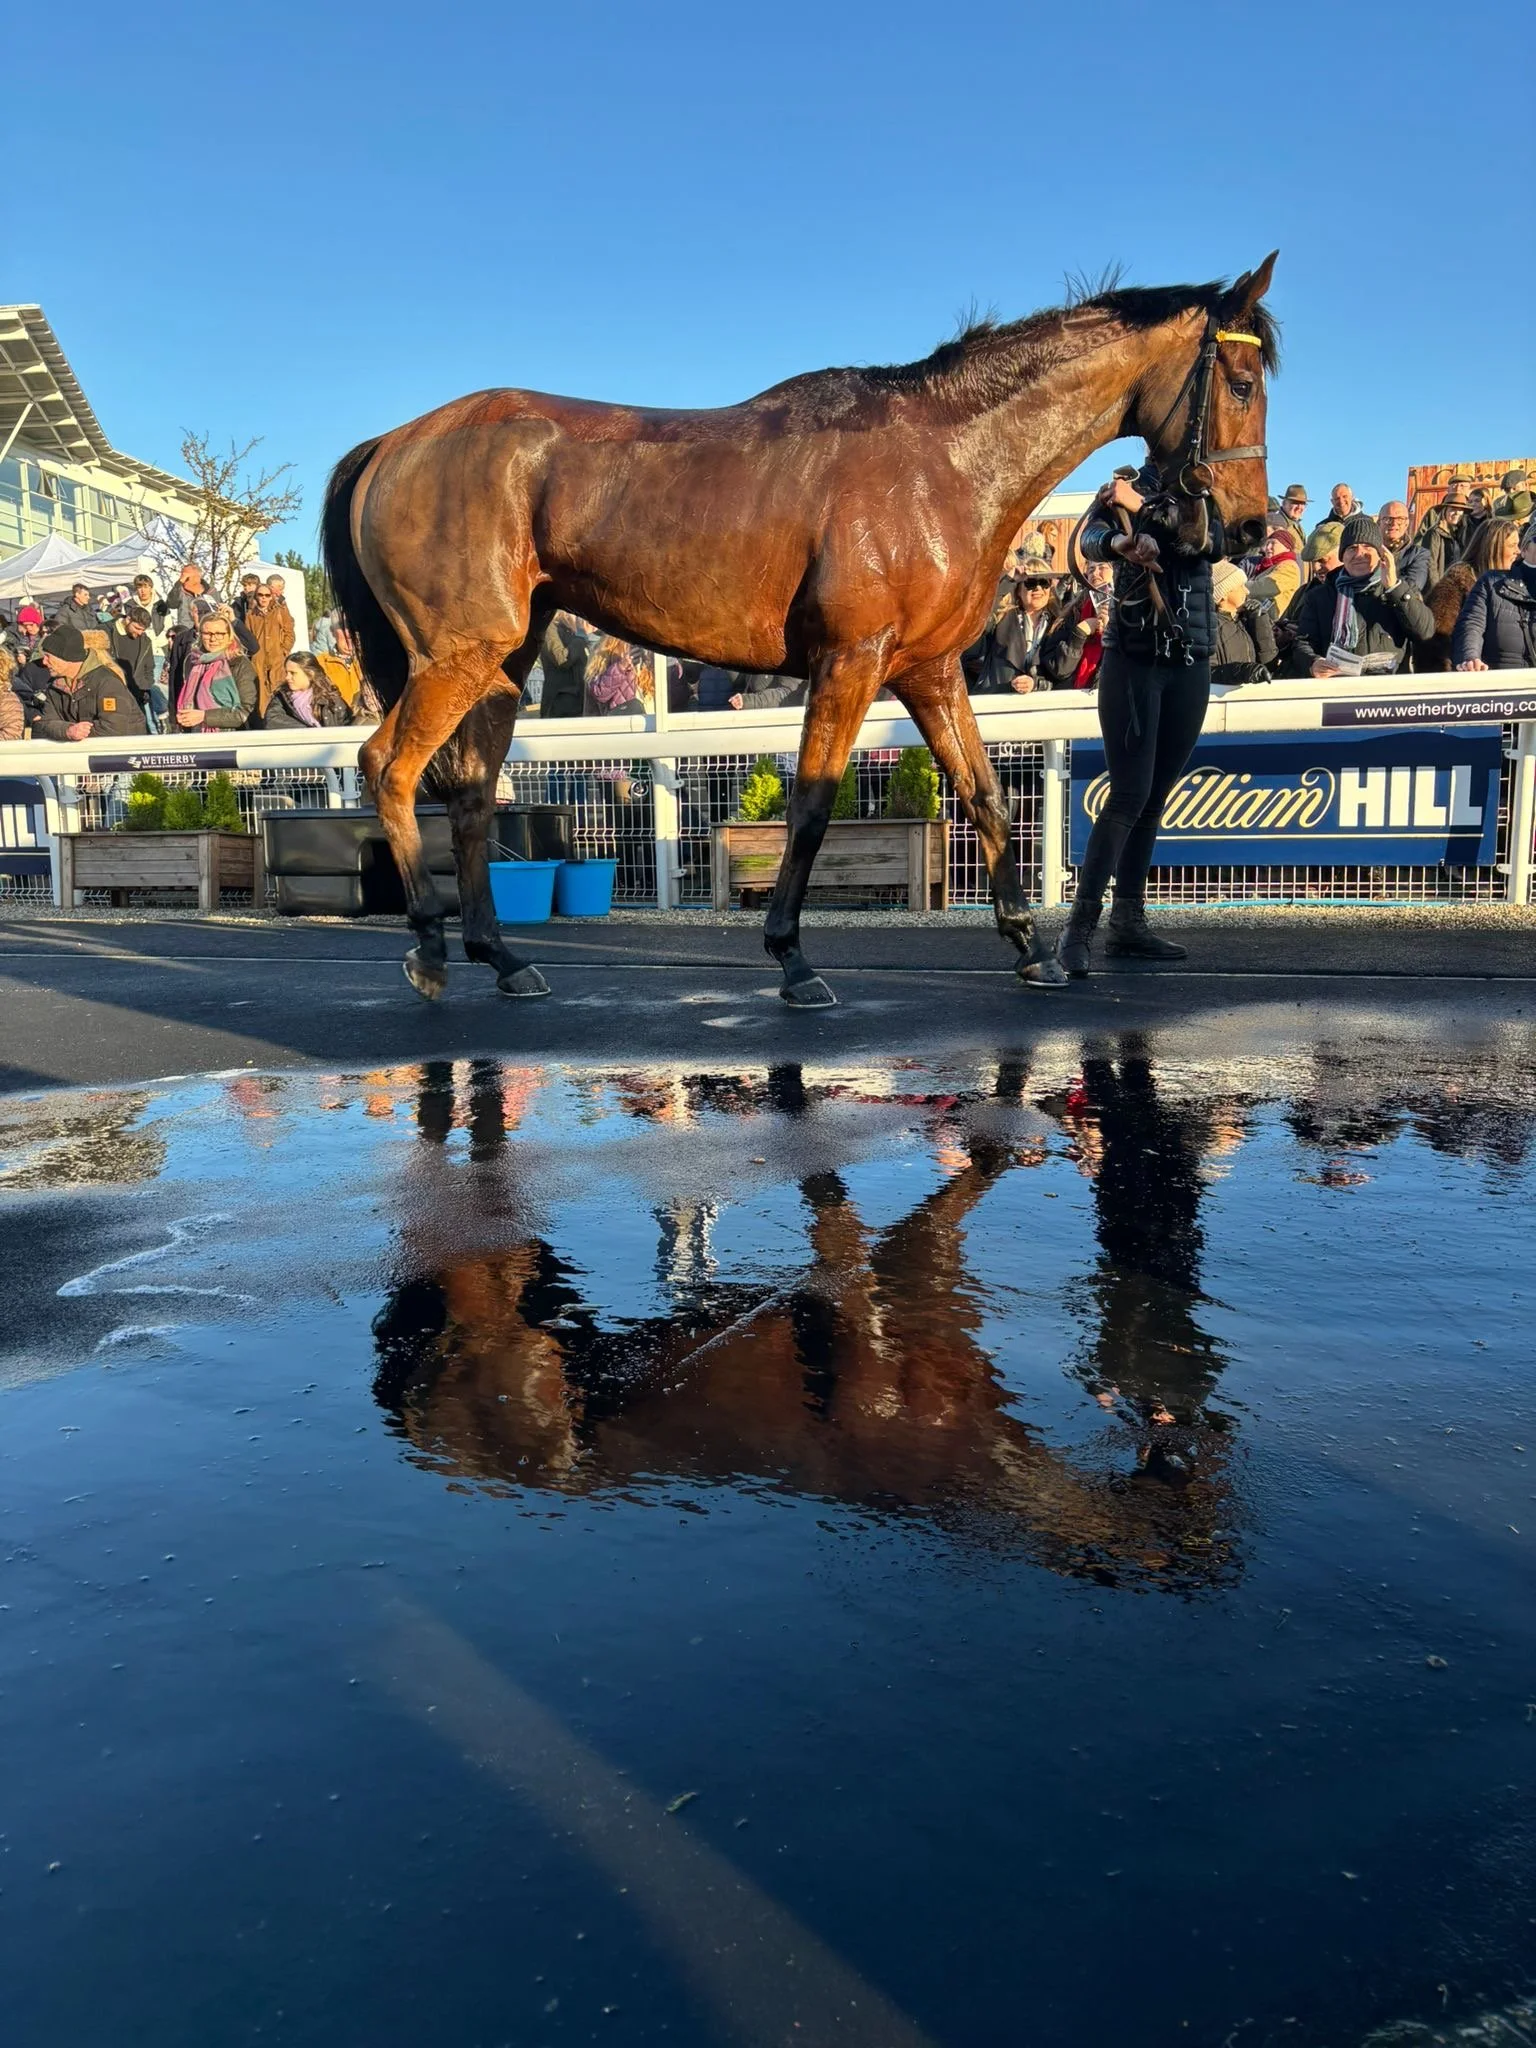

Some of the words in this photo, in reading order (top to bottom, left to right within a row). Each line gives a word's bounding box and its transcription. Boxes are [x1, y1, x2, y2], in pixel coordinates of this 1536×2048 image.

[1355, 699, 1536, 718] www.wetherbyracing.co
[141, 754, 197, 765] WETHERBY
[1339, 765, 1483, 827] HILL
[0, 803, 51, 848] ILL
